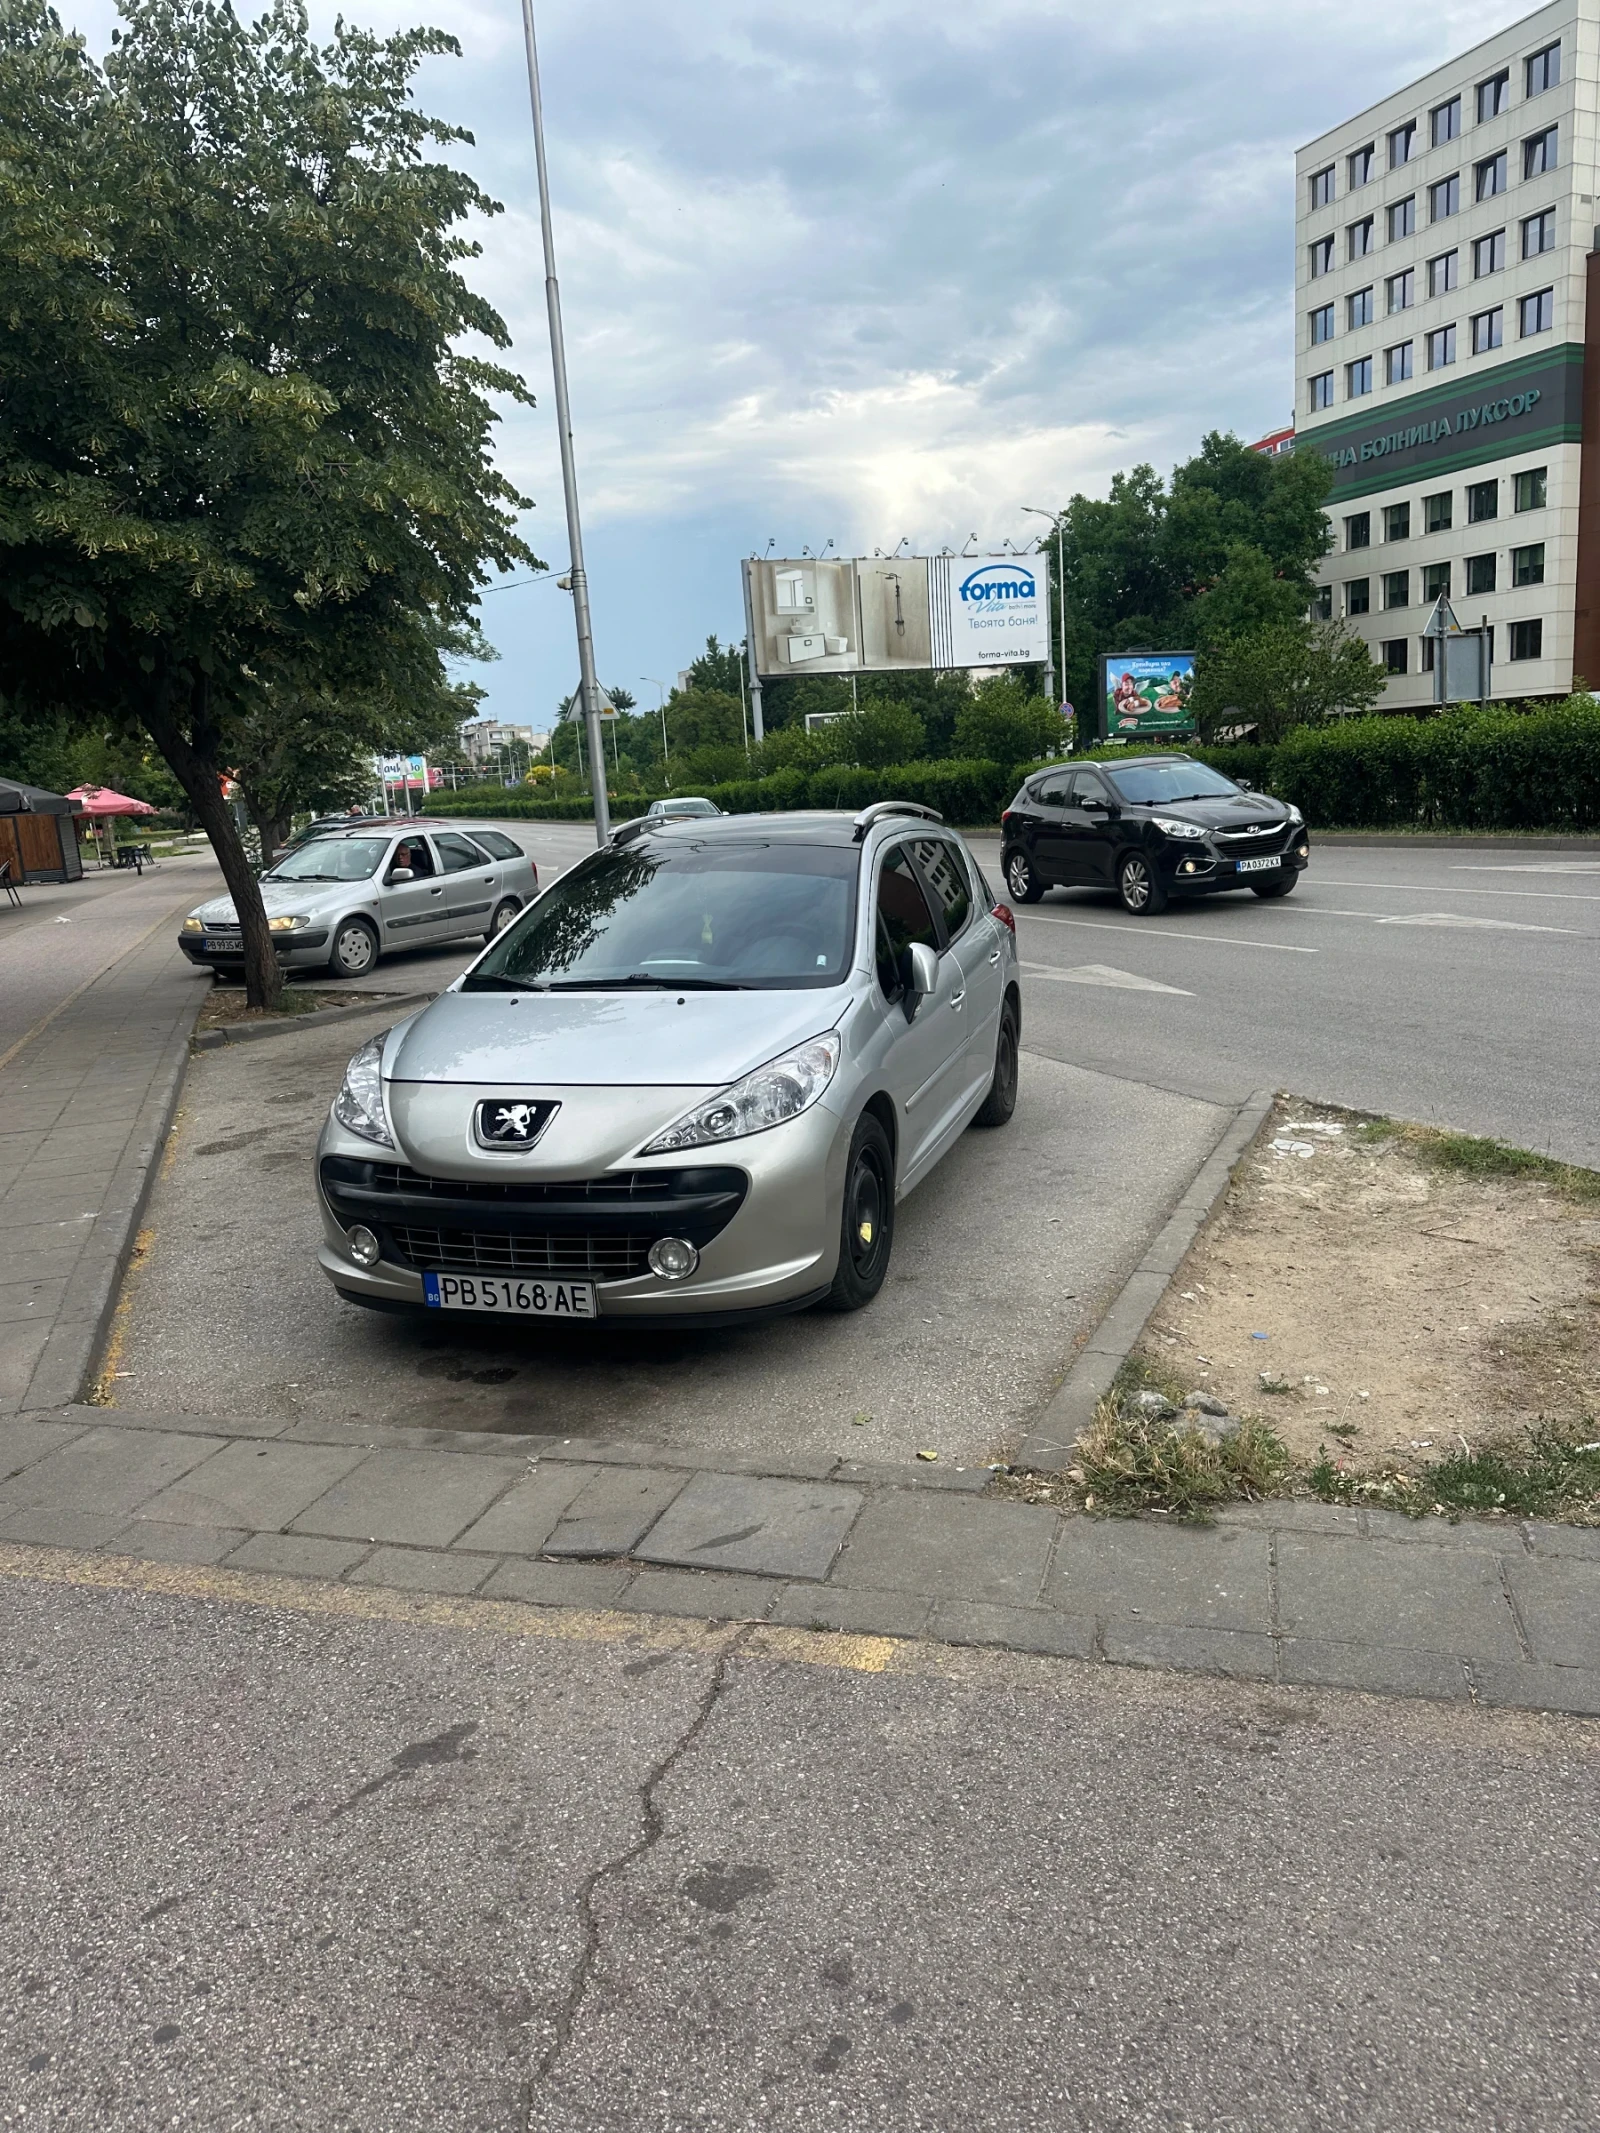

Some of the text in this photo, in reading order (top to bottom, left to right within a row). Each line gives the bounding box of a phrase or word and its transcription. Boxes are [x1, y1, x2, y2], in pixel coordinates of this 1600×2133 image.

[1323, 389, 1541, 469] НА БОЛНИЦА ЛУКСОР
[959, 565, 1036, 601] forma
[967, 590, 1005, 613] Vita
[968, 614, 1038, 629] Твоята баня!
[978, 648, 1030, 659] forma-vita.bg
[428, 1293, 440, 1302] BG
